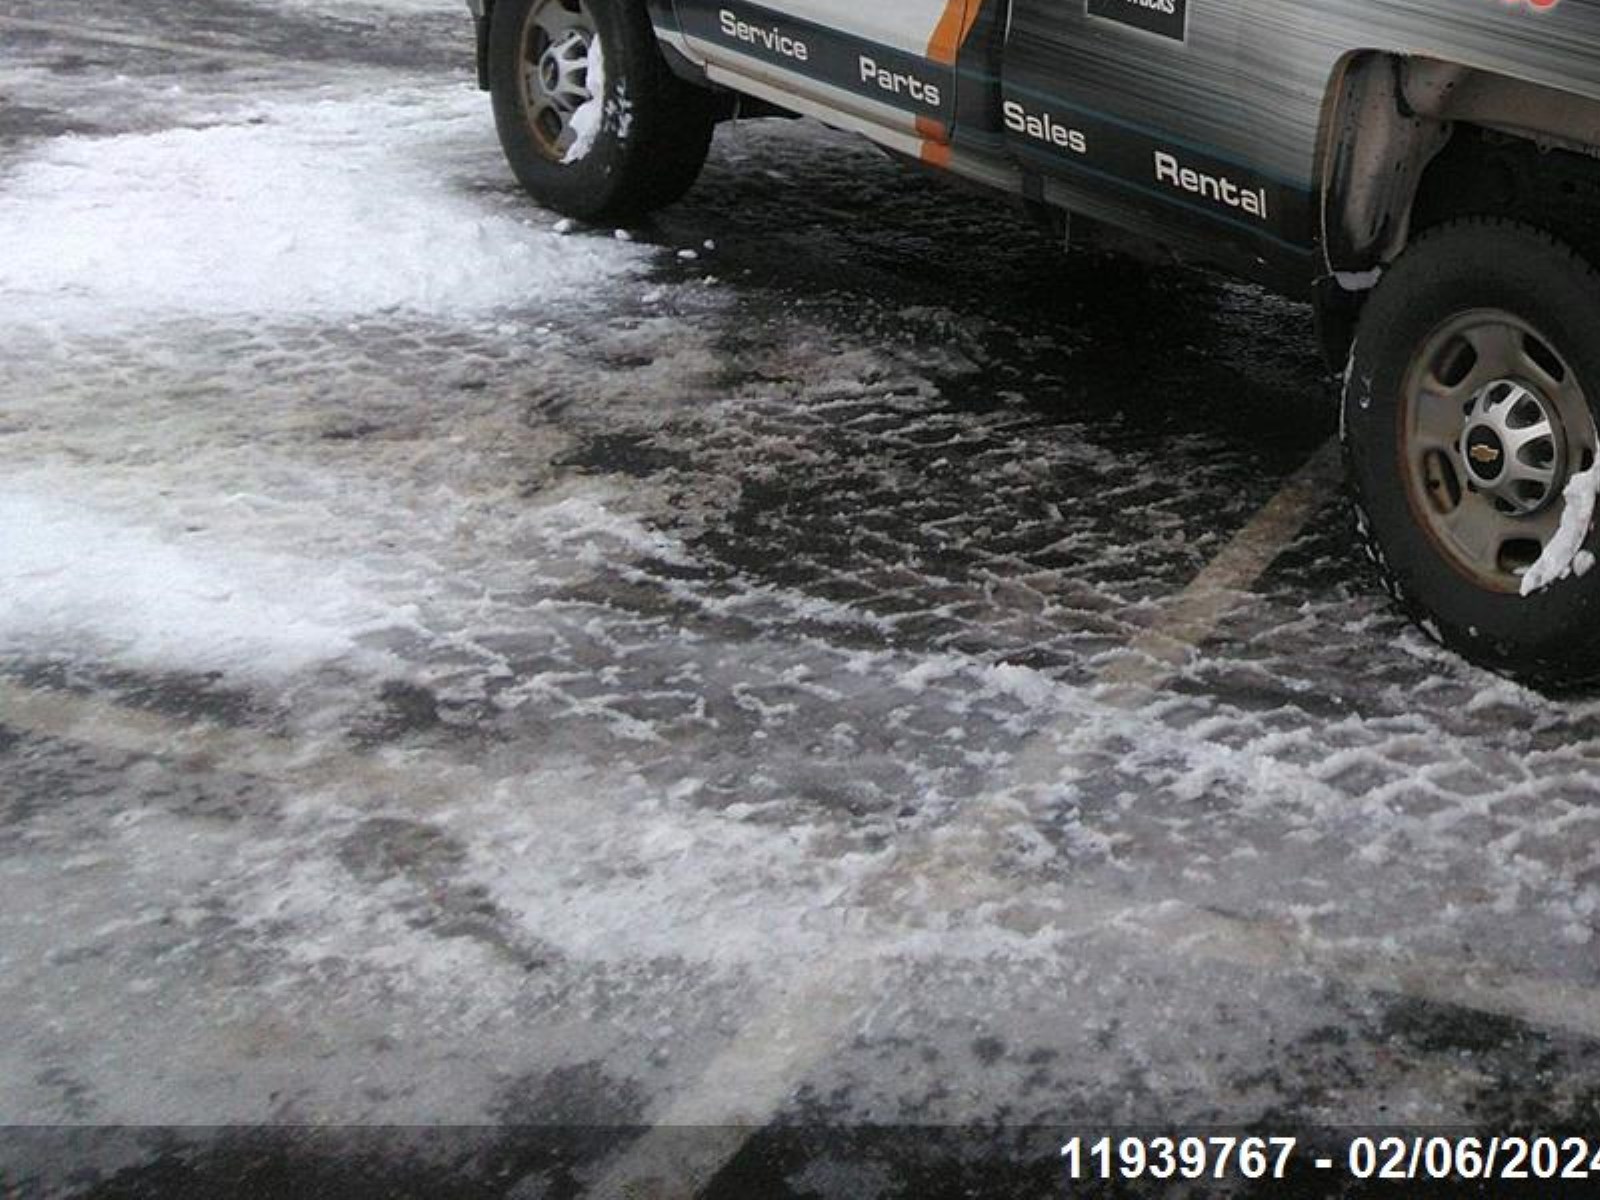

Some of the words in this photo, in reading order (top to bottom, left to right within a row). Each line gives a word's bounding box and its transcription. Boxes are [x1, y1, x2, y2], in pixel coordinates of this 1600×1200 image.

[719, 9, 809, 62] Service
[858, 54, 940, 106] Parts
[1002, 100, 1087, 154] Sales
[1154, 150, 1267, 219] Rental
